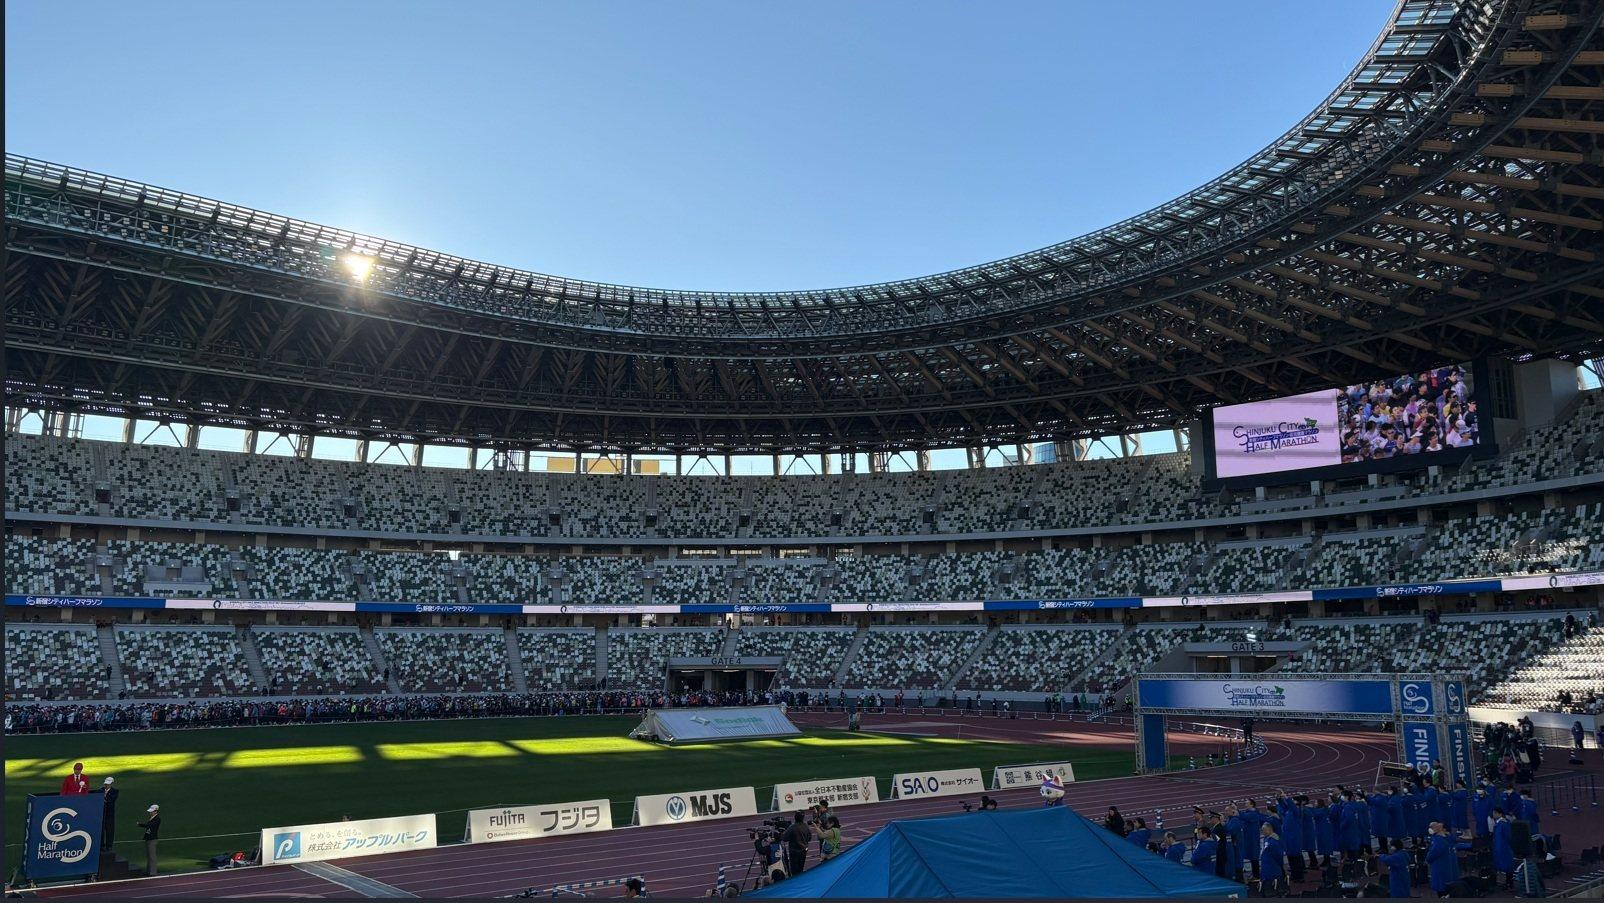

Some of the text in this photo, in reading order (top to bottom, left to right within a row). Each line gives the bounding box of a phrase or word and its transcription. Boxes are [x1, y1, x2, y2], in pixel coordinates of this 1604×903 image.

[1278, 422, 1298, 434] CITY
[1246, 441, 1268, 453] HALF
[1271, 435, 1318, 450] MARATHON
[1232, 642, 1265, 651] GATE 3
[711, 657, 734, 665] GATE
[1413, 728, 1431, 776] FINIS
[690, 793, 733, 817] MJS
[490, 810, 525, 827] FUJITA
[540, 806, 600, 832] フジタ
[38, 842, 58, 851] Half
[342, 831, 428, 850] アップルパーク
[38, 848, 83, 859] Marathon
